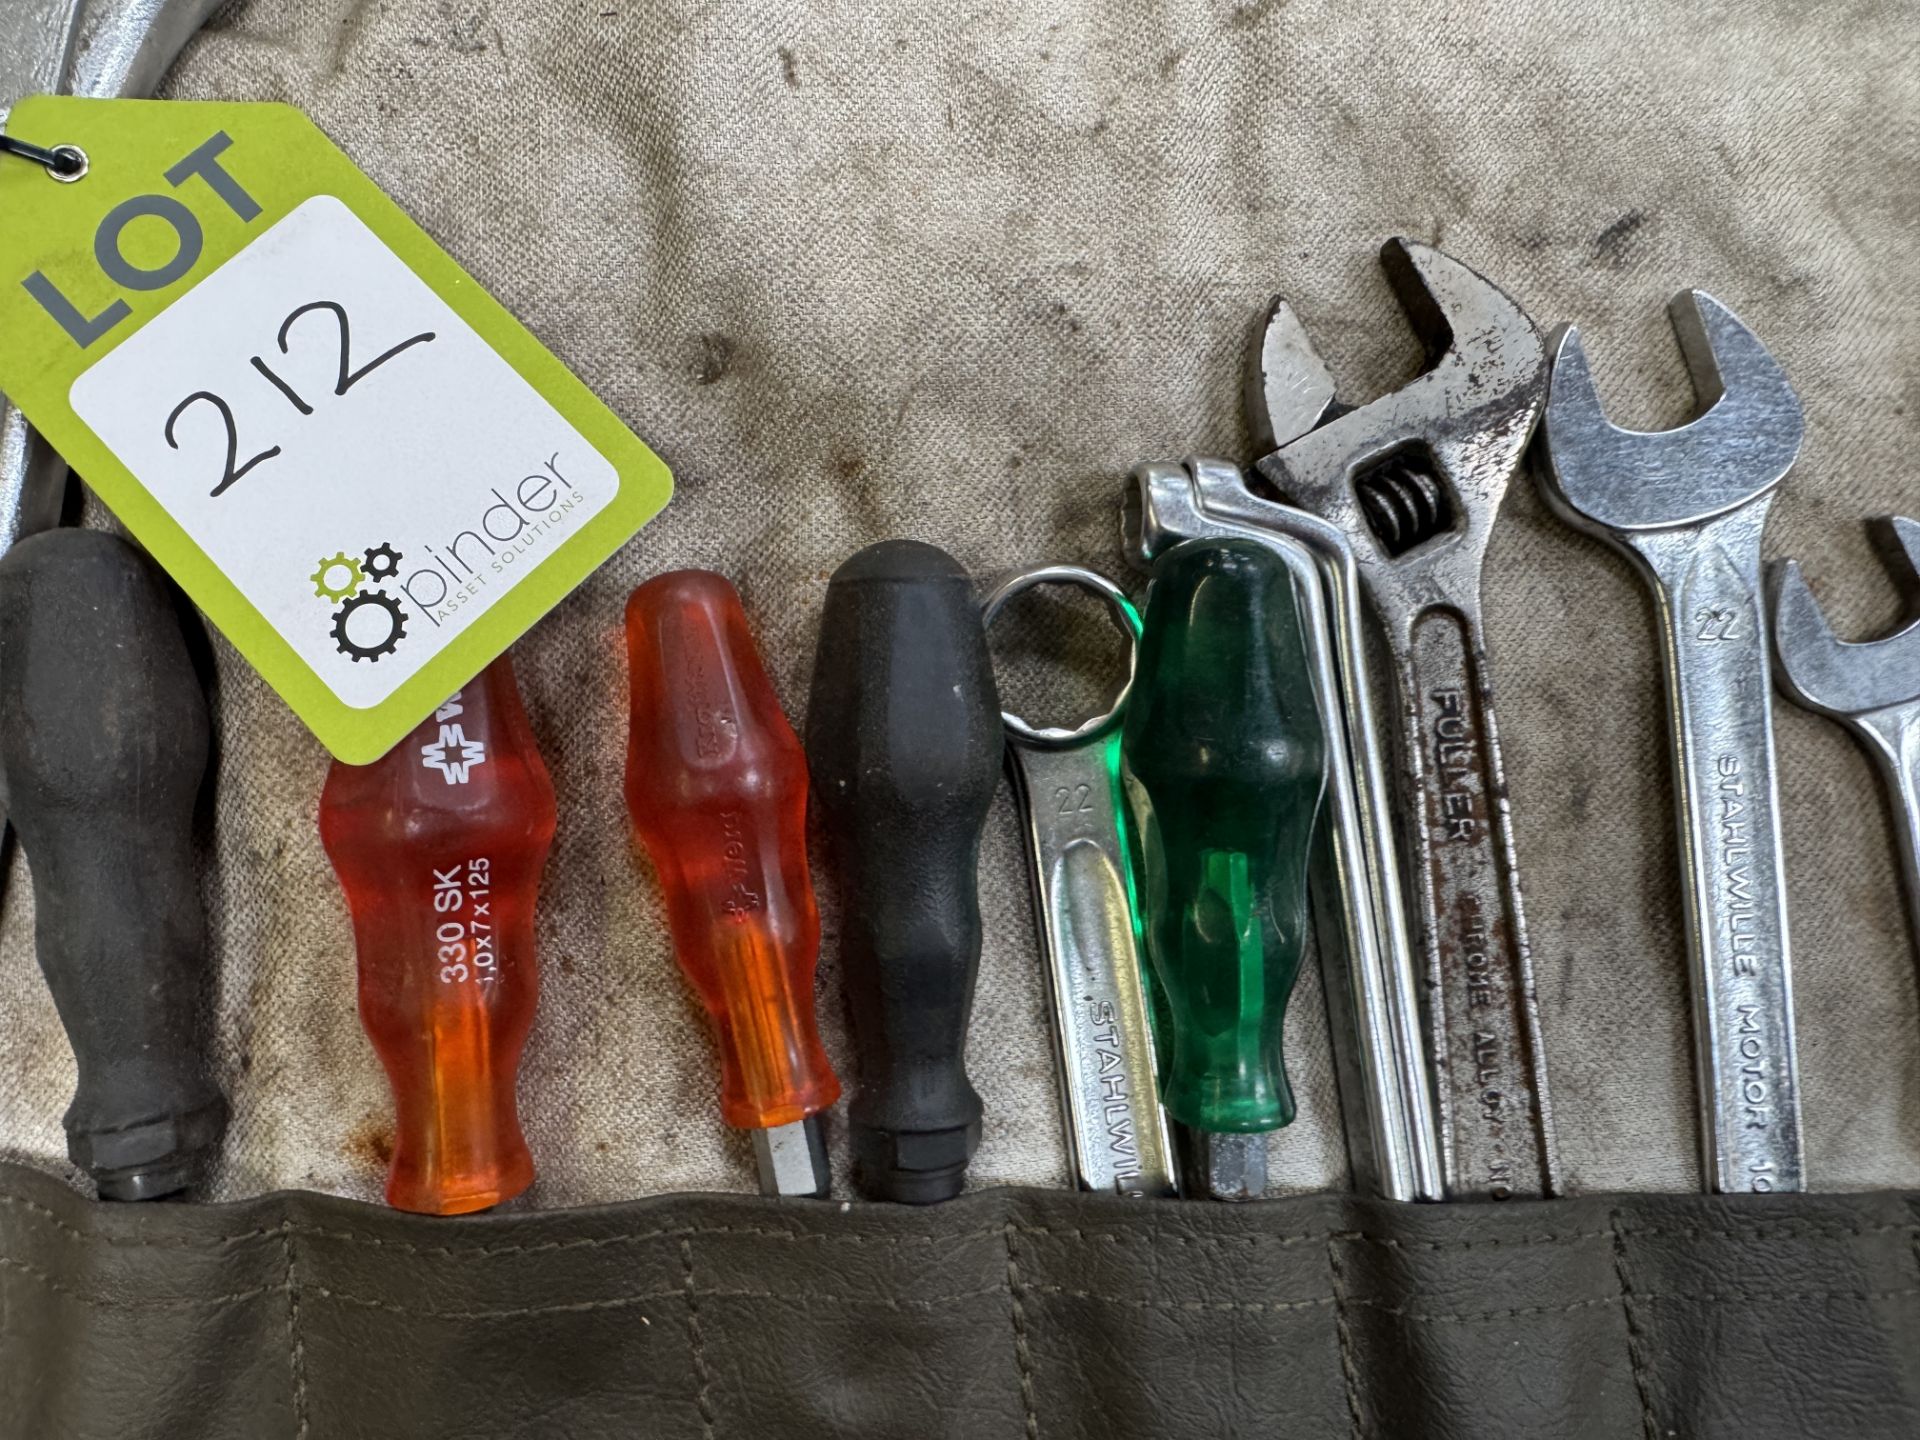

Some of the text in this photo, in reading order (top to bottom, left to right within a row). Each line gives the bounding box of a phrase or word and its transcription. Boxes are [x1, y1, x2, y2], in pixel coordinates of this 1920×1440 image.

[20, 130, 263, 350] LOT
[165, 300, 436, 497] 212
[400, 451, 572, 627] pinder
[437, 490, 584, 621] ASSET SOLUTIONS
[1694, 605, 1741, 642] 22
[1054, 783, 1093, 816] 22
[1717, 754, 1758, 979] STAHLWILLE
[433, 864, 469, 984] 330 SK
[1430, 688, 1477, 842] FULLER
[1472, 1030, 1506, 1126] ALLOY
[1088, 1000, 1144, 1198] STAHLWIL
[1736, 1004, 1770, 1132] MOTOR
